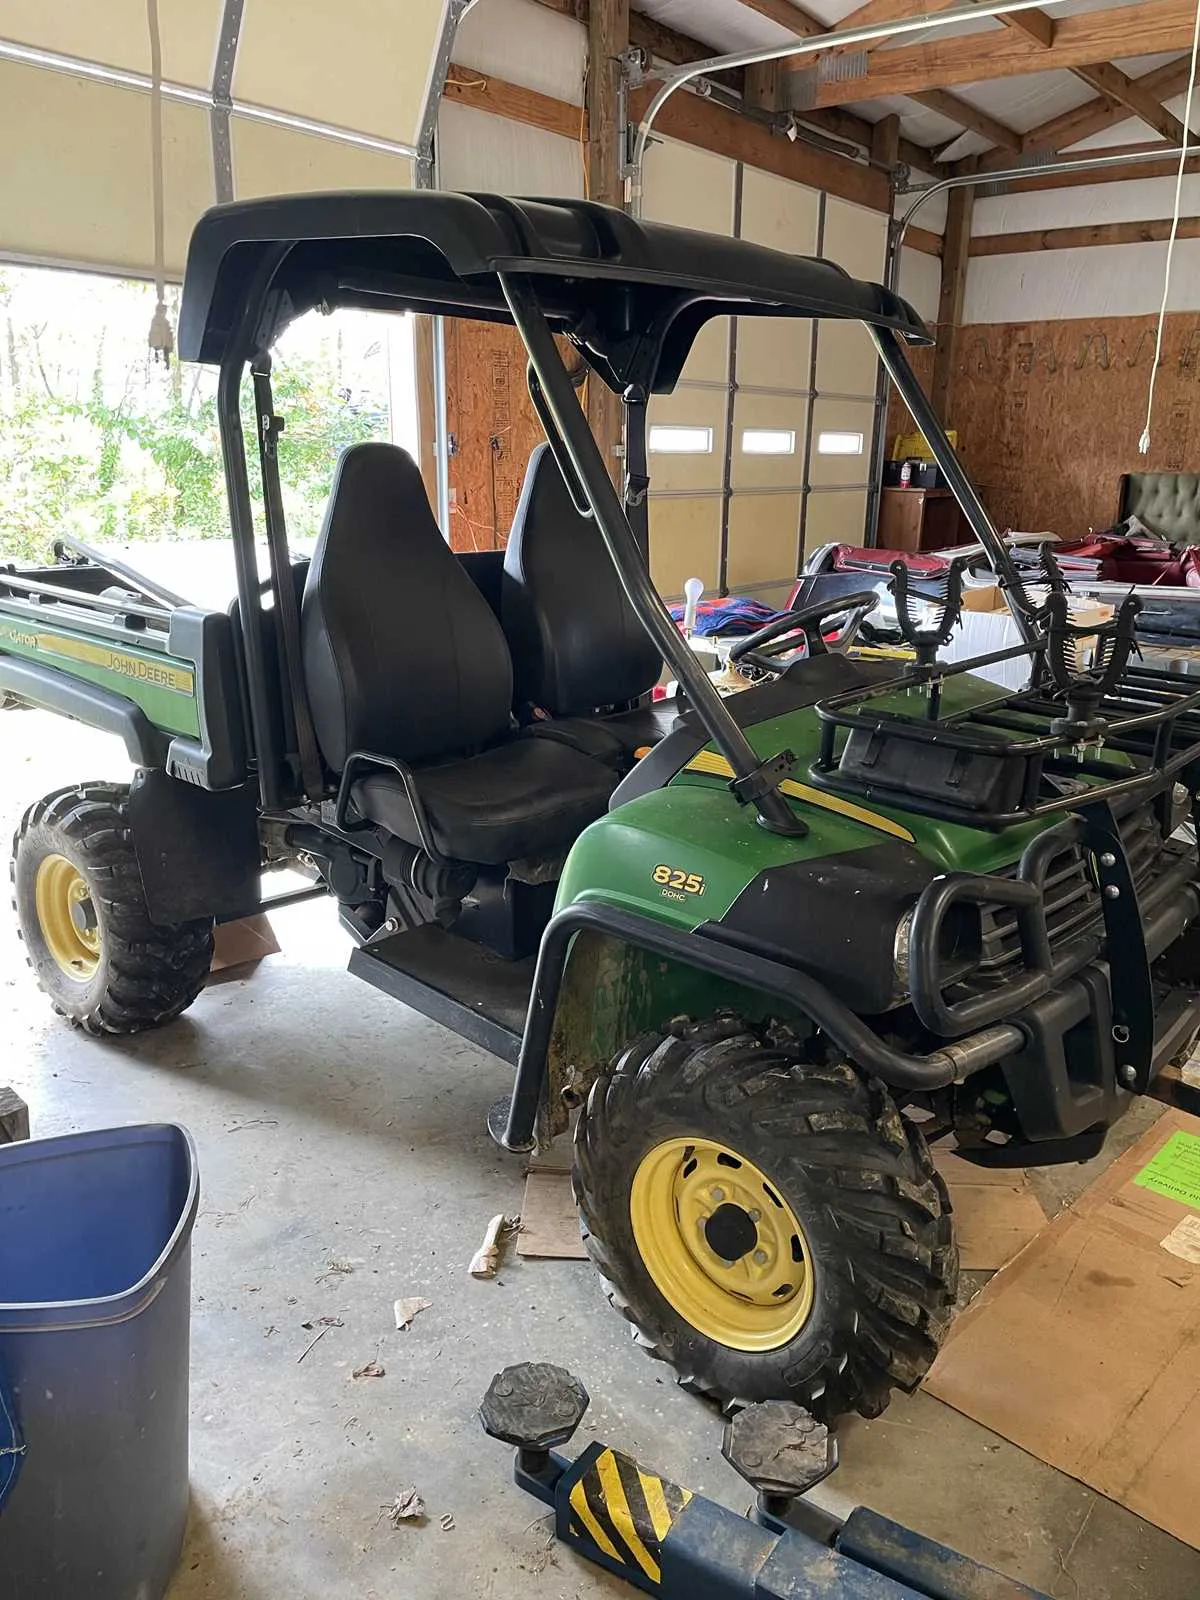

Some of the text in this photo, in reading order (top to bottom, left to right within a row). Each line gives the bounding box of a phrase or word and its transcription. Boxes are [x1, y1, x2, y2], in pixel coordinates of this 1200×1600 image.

[106, 653, 176, 686] JOHN DEERE
[652, 864, 706, 896] 825i
[661, 888, 686, 901] DOHC
